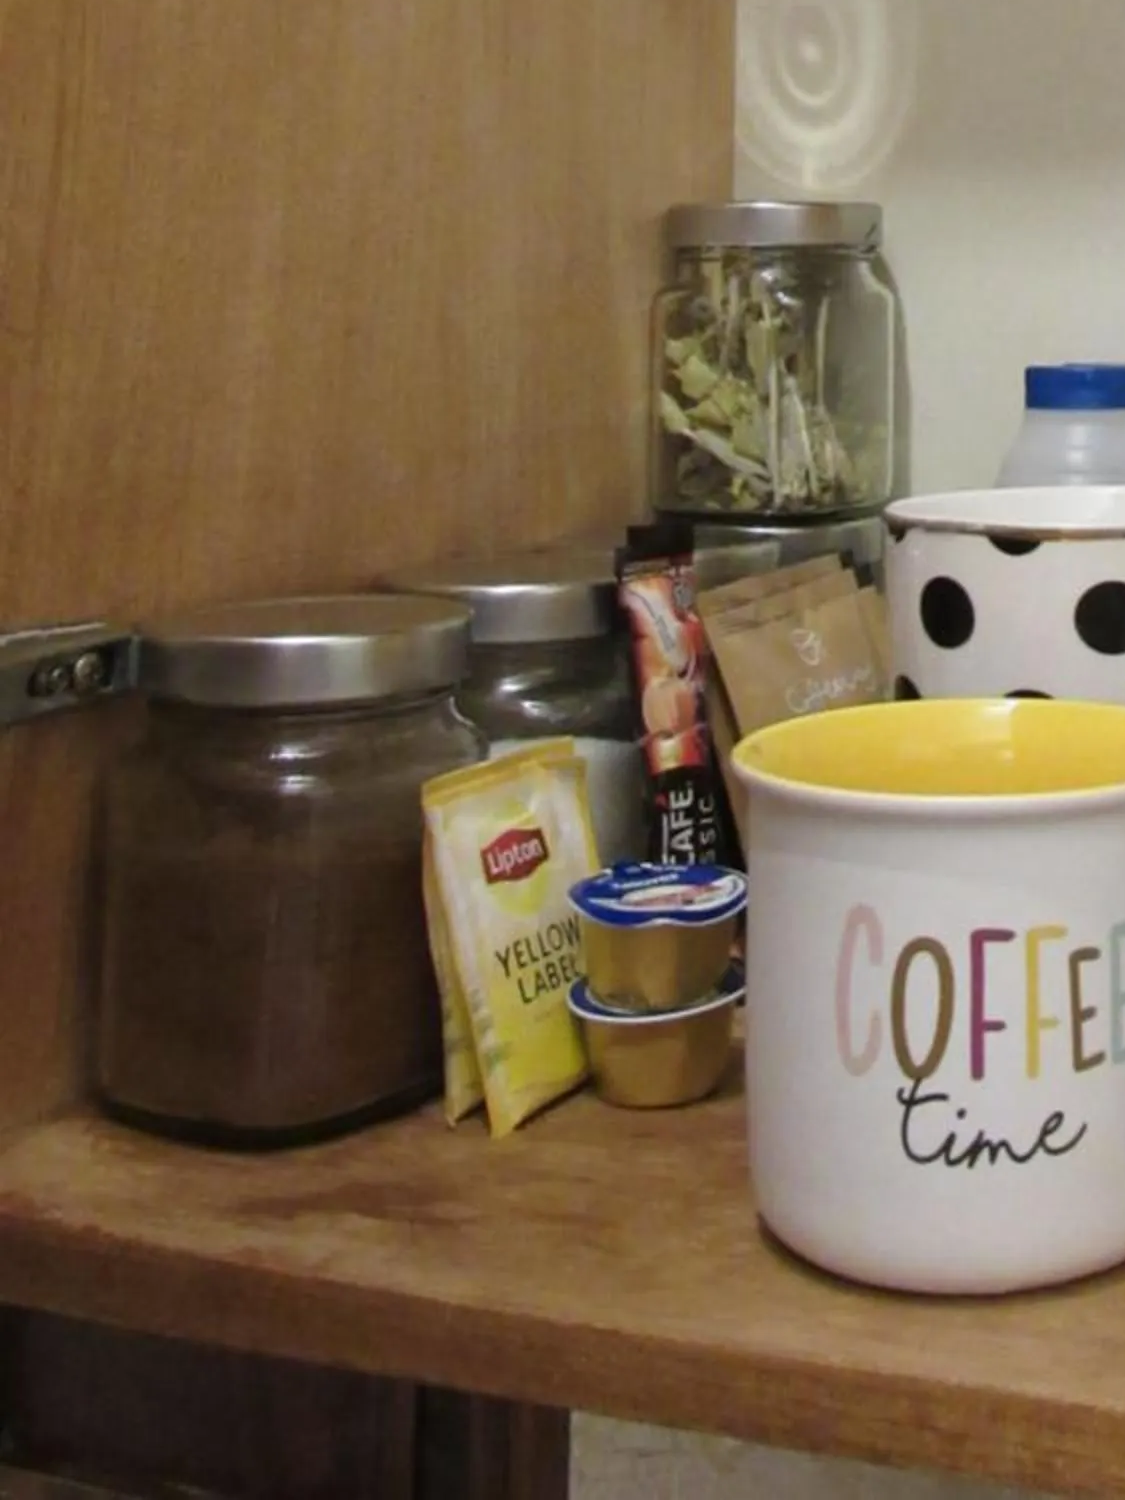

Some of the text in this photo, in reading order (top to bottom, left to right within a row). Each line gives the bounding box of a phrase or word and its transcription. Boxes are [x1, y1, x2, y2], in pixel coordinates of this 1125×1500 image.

[486, 838, 545, 877] Lipton
[495, 915, 581, 979] YELLOW
[517, 953, 582, 1004] LABEL
[897, 1078, 1087, 1169] time
